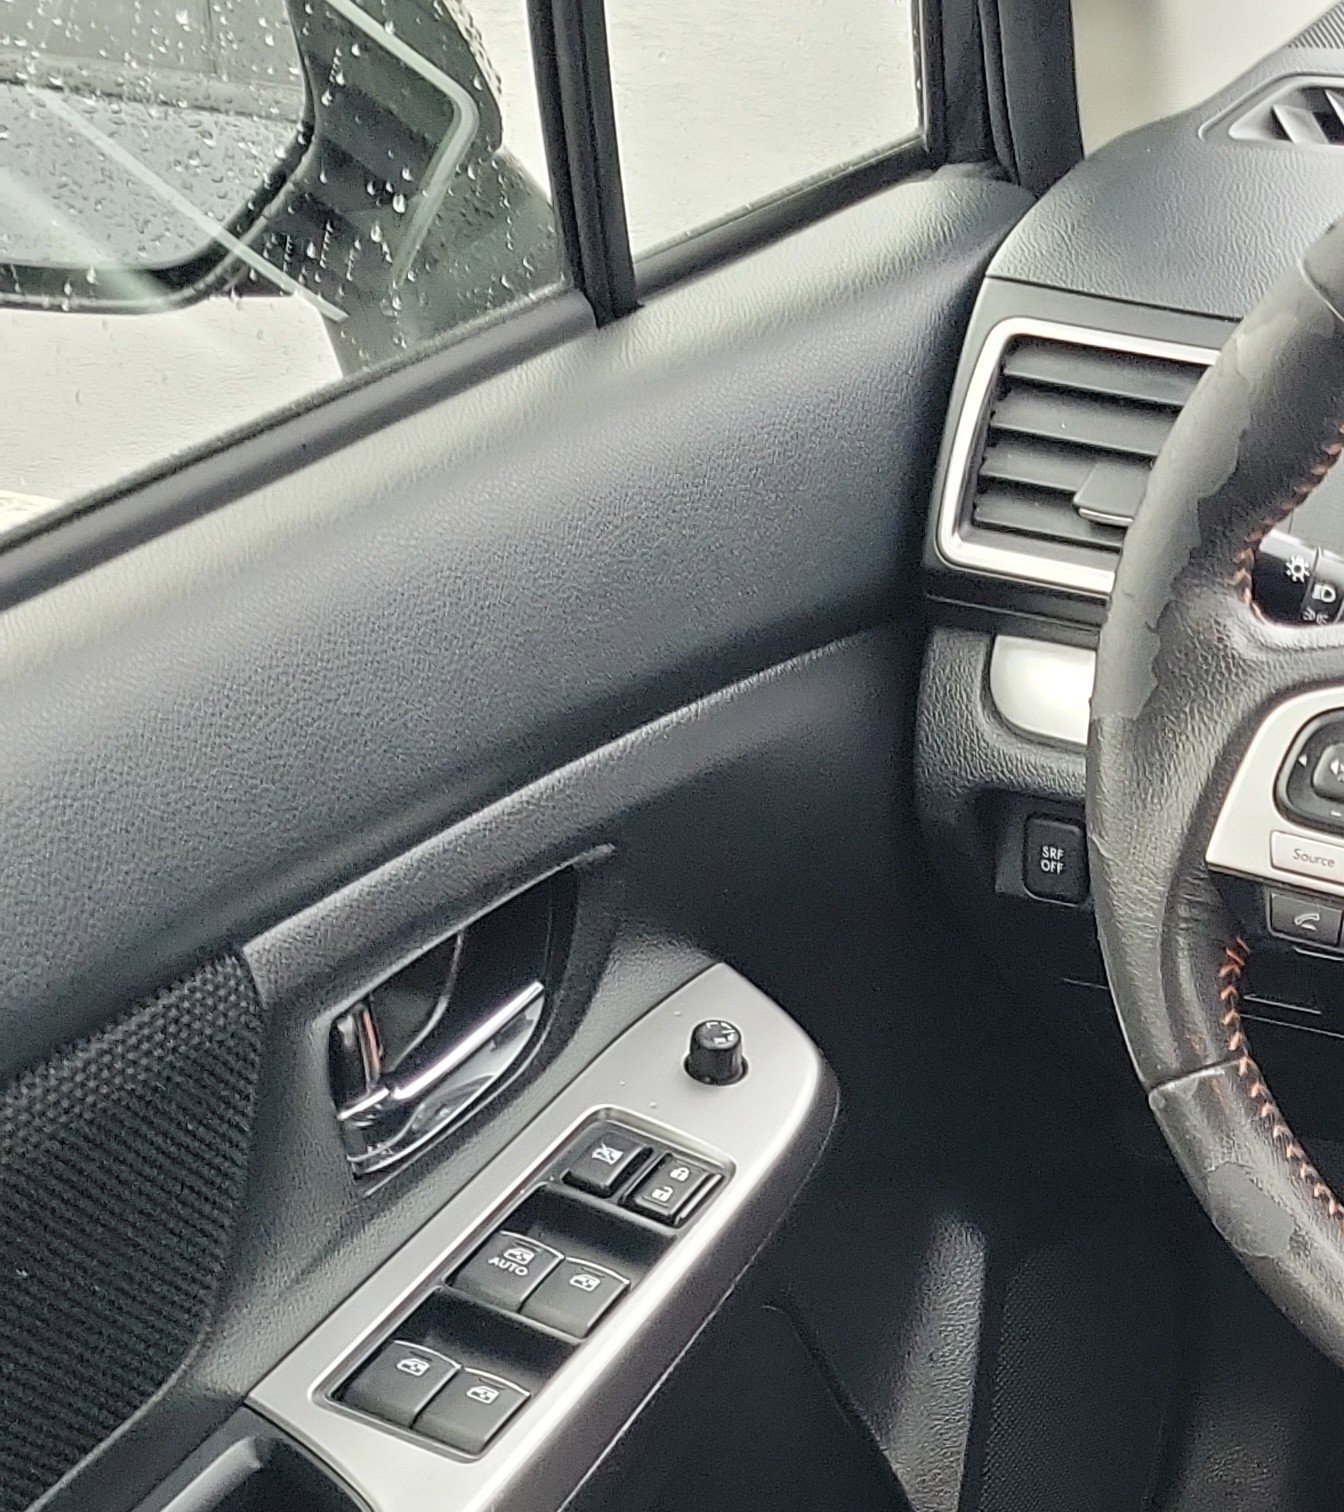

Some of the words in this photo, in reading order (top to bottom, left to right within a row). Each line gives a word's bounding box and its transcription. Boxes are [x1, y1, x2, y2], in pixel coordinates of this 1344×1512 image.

[1041, 845, 1065, 861] SRF
[1293, 848, 1336, 869] Source
[1040, 859, 1065, 875] OFF
[488, 1255, 529, 1277] AUTO
